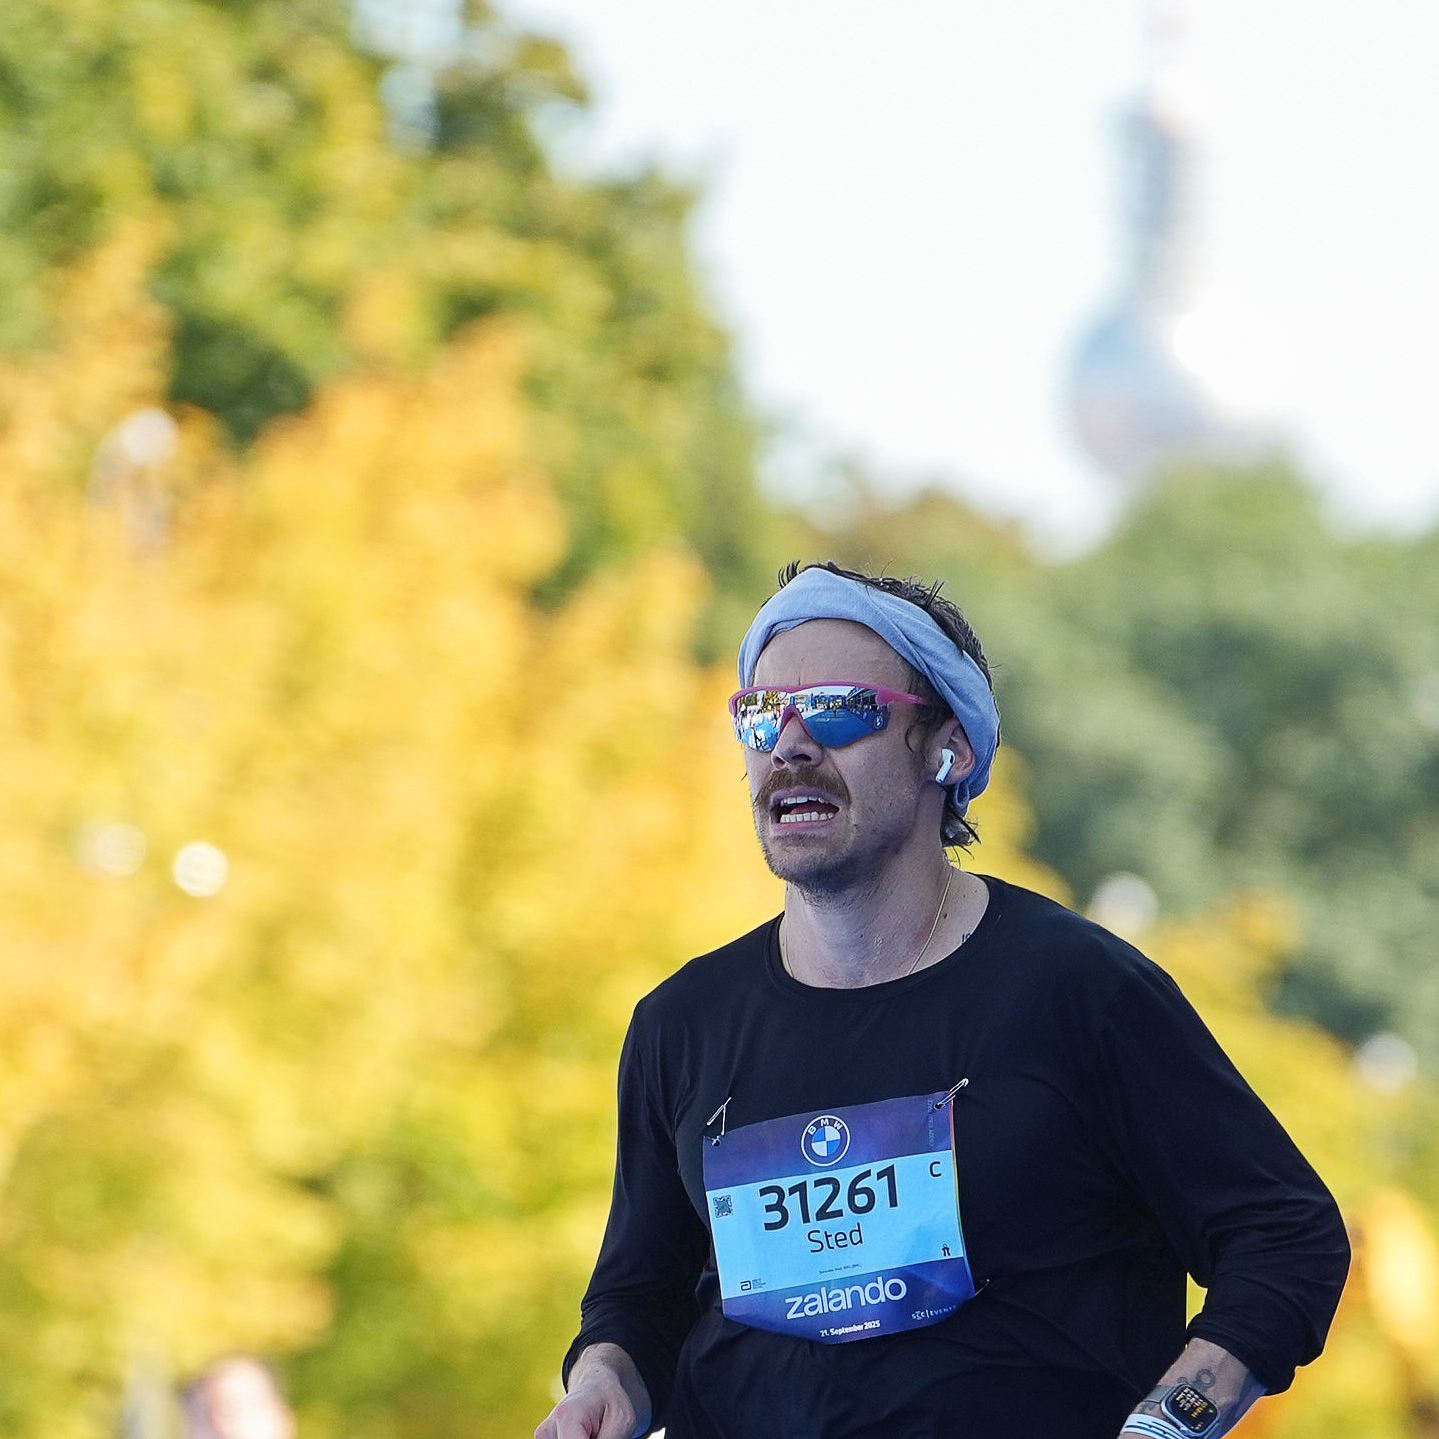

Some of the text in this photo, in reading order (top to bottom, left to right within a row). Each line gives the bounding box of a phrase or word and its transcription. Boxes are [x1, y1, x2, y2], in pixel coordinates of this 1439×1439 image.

[807, 1118, 843, 1136] BMW
[929, 1160, 942, 1179] C
[758, 1163, 899, 1232] 31261
[807, 1222, 864, 1254] Sted
[784, 1277, 908, 1321] zalando
[829, 1324, 864, 1336] September
[863, 1319, 881, 1330] 2025
